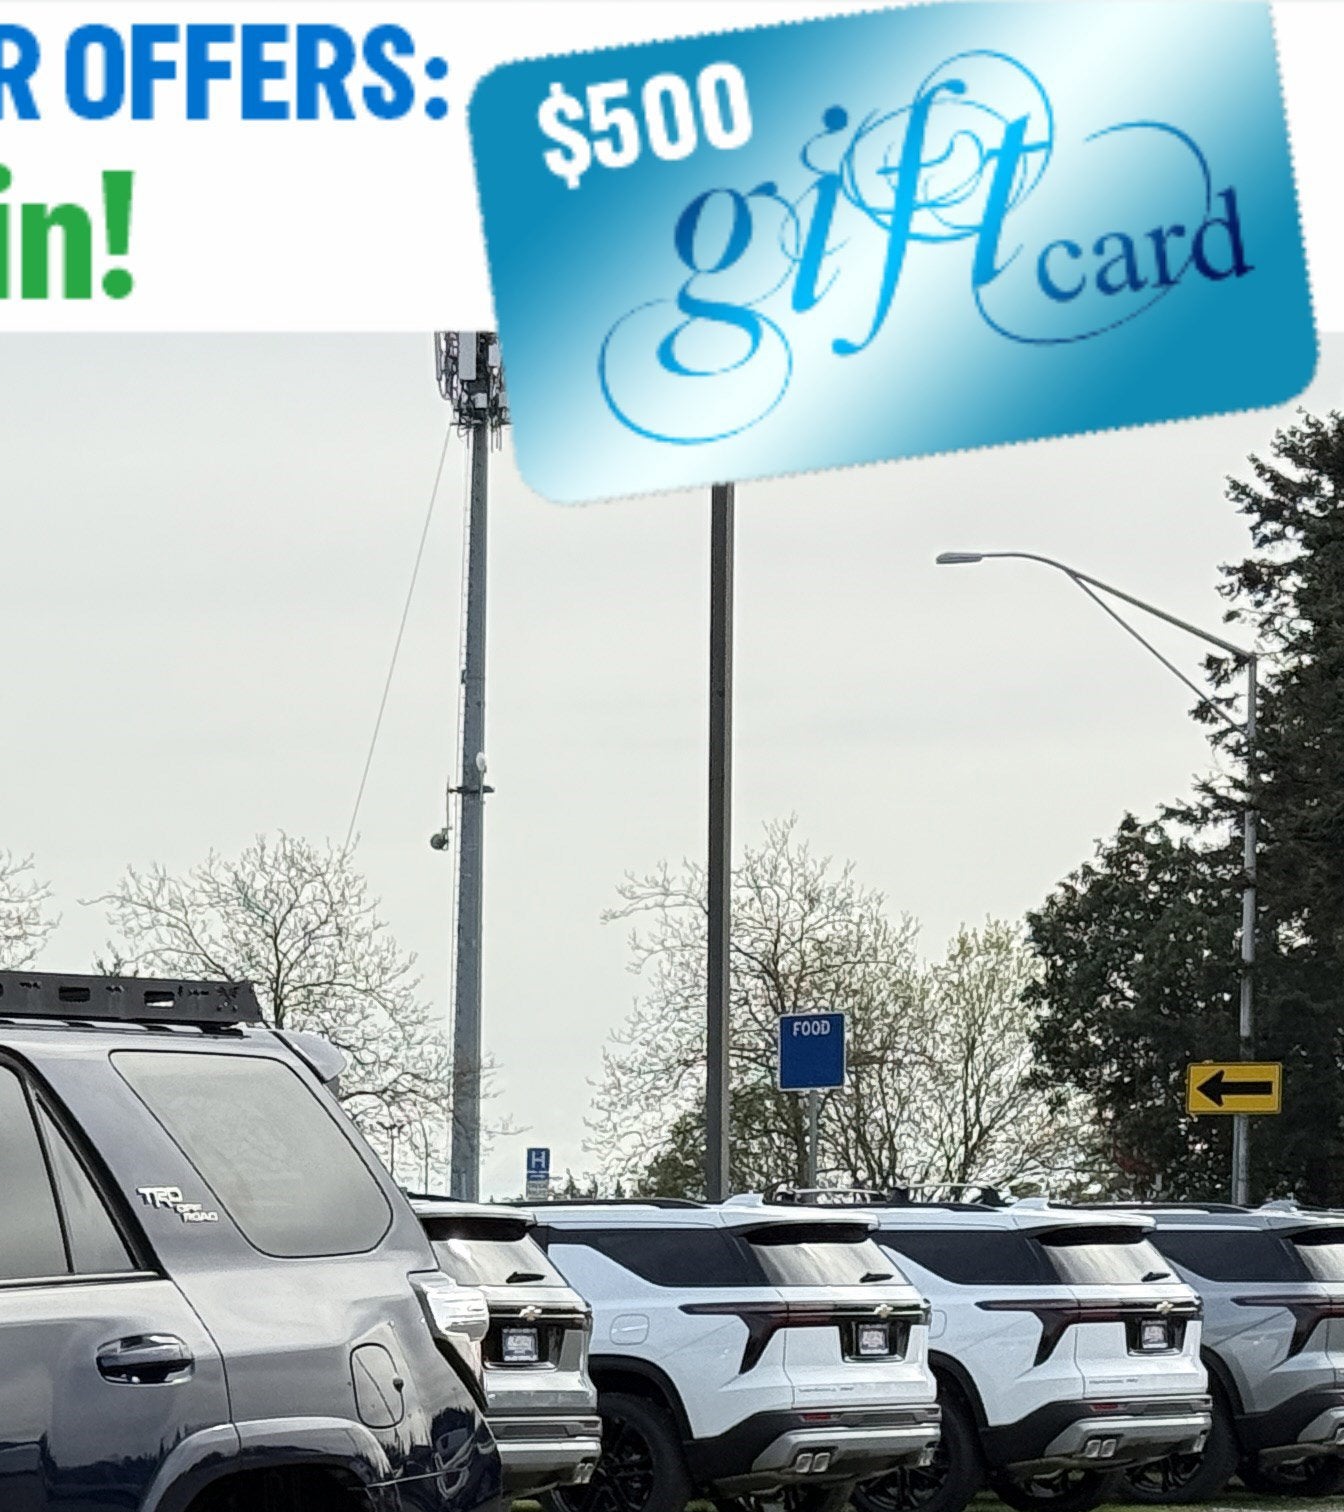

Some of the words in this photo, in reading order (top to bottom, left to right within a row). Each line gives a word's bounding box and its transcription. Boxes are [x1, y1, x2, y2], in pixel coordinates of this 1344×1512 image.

[792, 1020, 831, 1037] FOOD
[532, 1150, 546, 1169] H
[135, 1186, 183, 1209] TRD
[181, 1212, 219, 1222] ROAD
